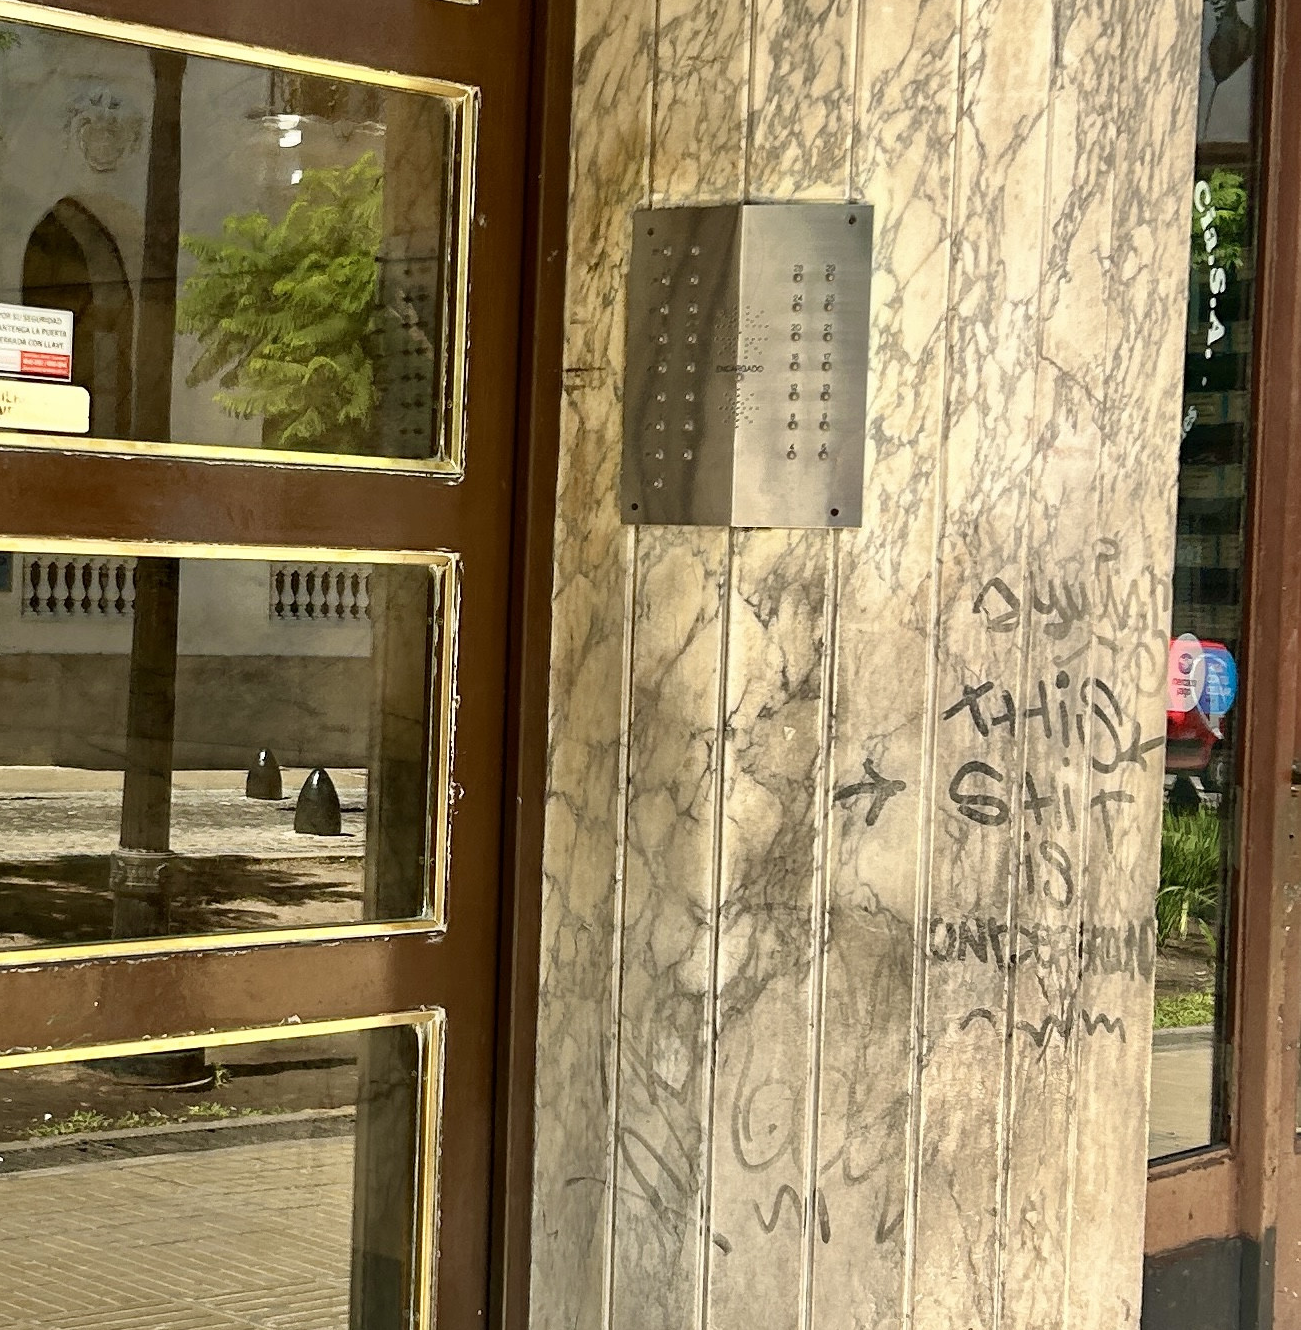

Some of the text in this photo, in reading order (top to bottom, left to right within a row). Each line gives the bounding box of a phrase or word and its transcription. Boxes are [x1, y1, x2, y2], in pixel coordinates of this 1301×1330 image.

[23, 313, 63, 325] SEGURIDAD
[790, 323, 802, 331] 20
[31, 327, 40, 335] LA
[41, 328, 67, 338] PUERTA
[27, 339, 43, 347] CON
[43, 341, 64, 349] LLAVE
